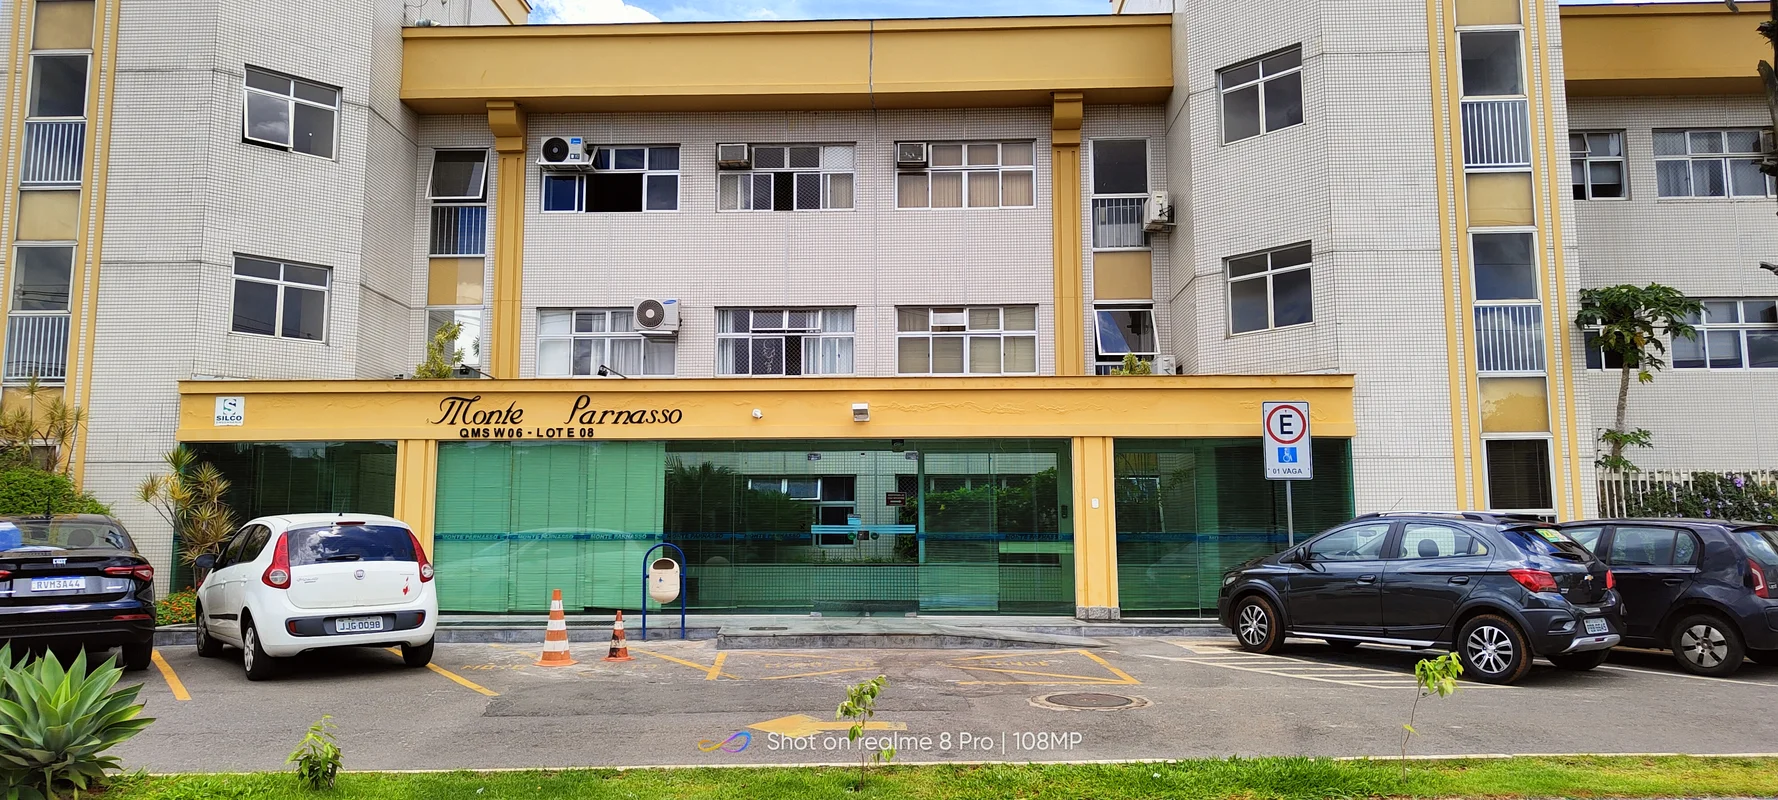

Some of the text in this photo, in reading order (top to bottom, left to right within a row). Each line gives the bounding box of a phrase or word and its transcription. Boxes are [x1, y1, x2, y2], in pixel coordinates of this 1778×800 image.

[431, 394, 683, 426] Monte Parnasso
[1280, 414, 1294, 435] E
[579, 427, 594, 438] 08
[1282, 467, 1303, 475] VAGA
[36, 580, 80, 590] RVM3A44
